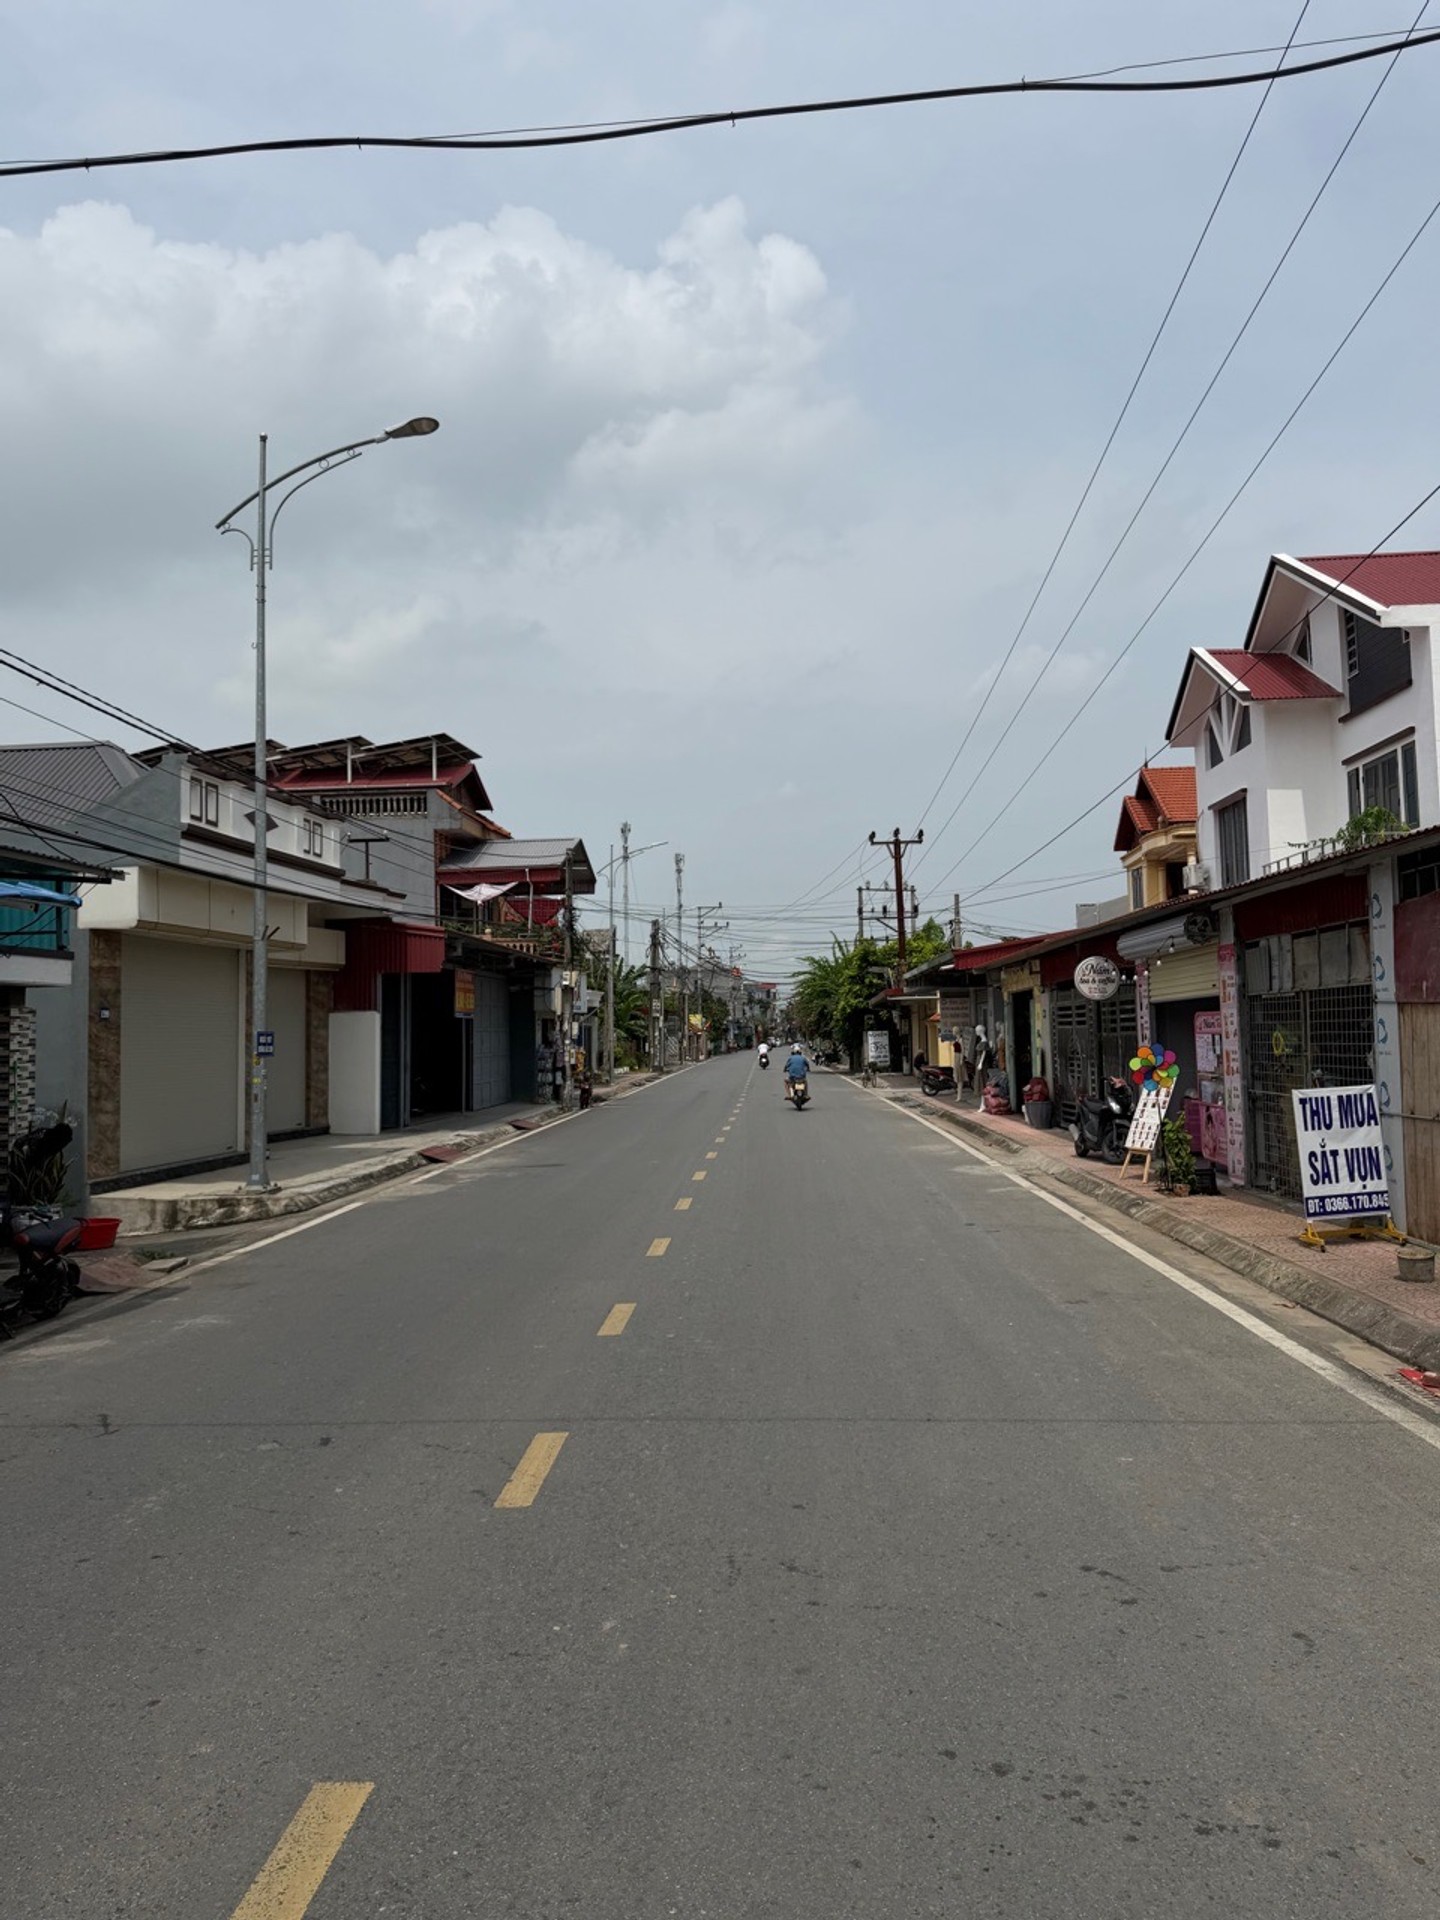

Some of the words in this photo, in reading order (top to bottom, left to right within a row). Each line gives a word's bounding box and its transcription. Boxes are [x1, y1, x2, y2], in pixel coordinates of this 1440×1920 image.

[1080, 976, 1090, 984] tea
[1098, 976, 1115, 985] coffee
[1298, 1096, 1334, 1132] THU
[1337, 1093, 1379, 1129] MUA
[1308, 1138, 1340, 1186] SẮT
[1344, 1146, 1382, 1190] VỤN
[1307, 1200, 1323, 1214] ĐT:
